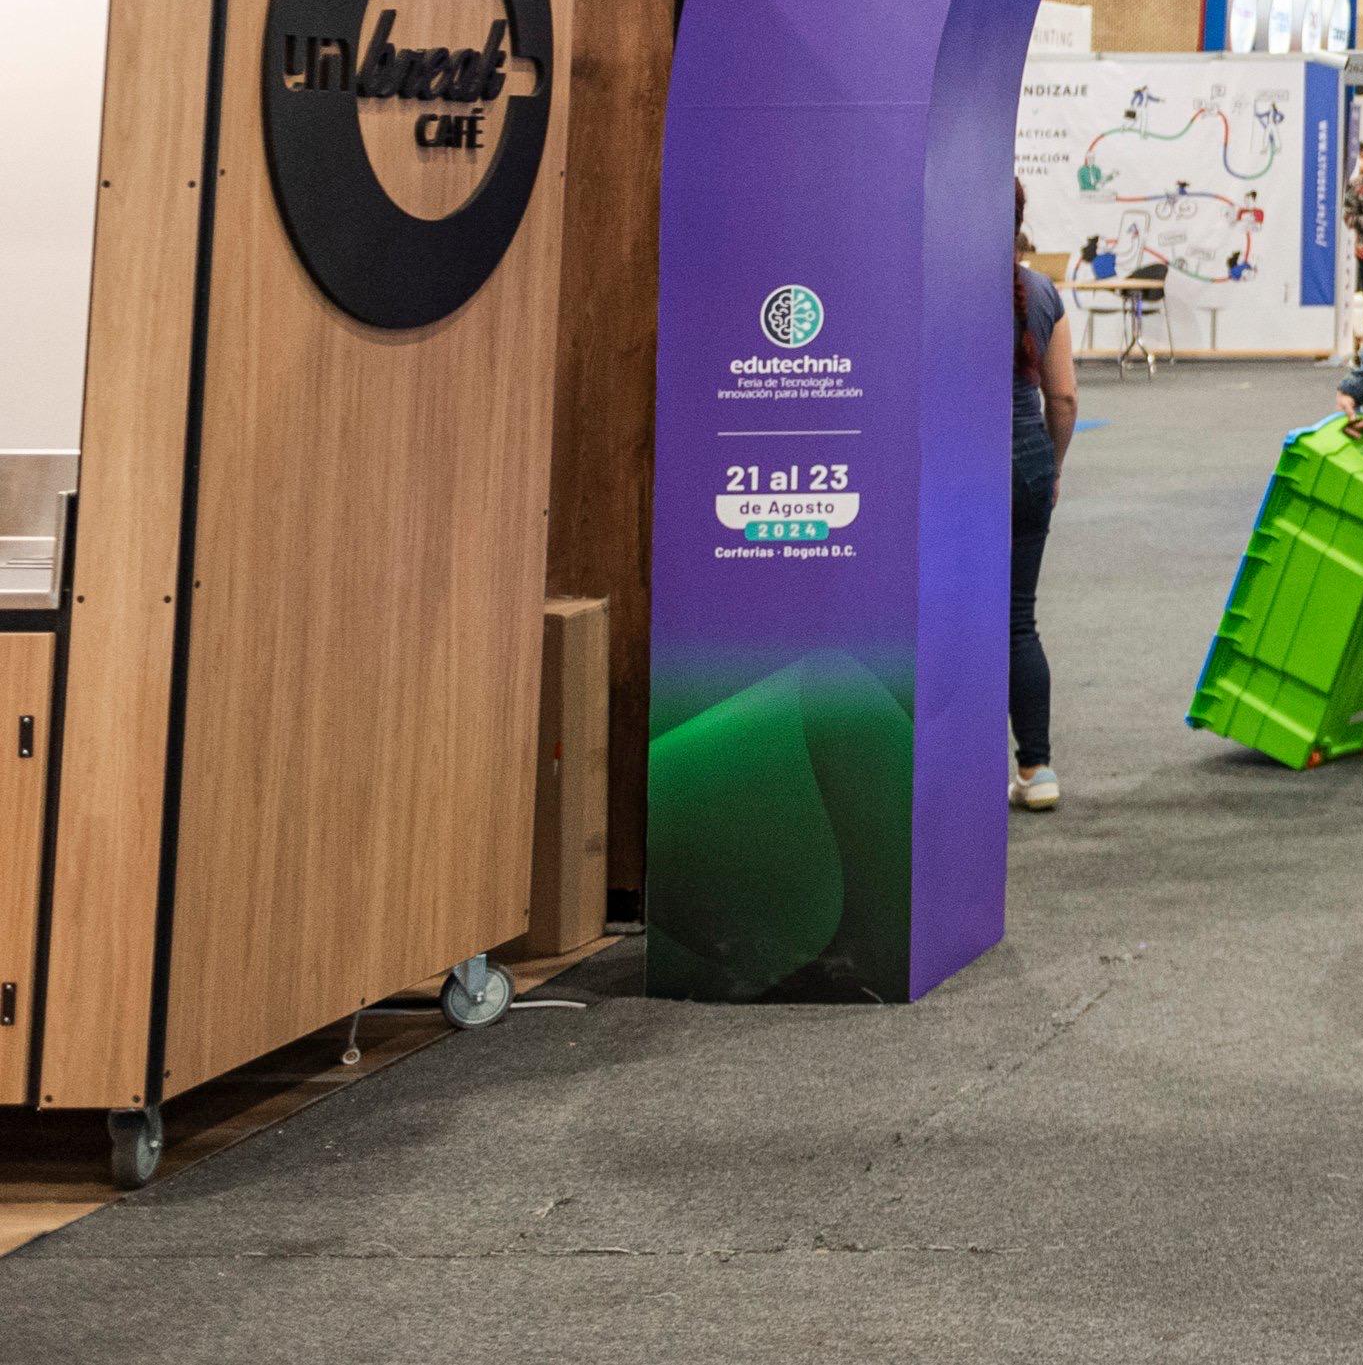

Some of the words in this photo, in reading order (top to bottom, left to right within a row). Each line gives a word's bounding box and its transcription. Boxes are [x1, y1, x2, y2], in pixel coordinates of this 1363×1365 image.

[414, 107, 485, 149] CAFÉ
[730, 355, 852, 374] edutechnia
[738, 377, 763, 387] Feria
[765, 377, 778, 387] de
[836, 378, 843, 387] e
[717, 388, 772, 399] innovación
[774, 389, 797, 400] para
[800, 387, 809, 398] la
[810, 387, 863, 398] educación
[726, 465, 760, 491] 21
[770, 465, 798, 491] al
[809, 464, 849, 490] 23
[739, 500, 761, 515] de
[768, 500, 835, 518] Agosto
[758, 523, 817, 538] 2024
[715, 546, 774, 559] Corferias
[783, 545, 828, 560] Bogotá
[831, 545, 857, 558] D.C.
